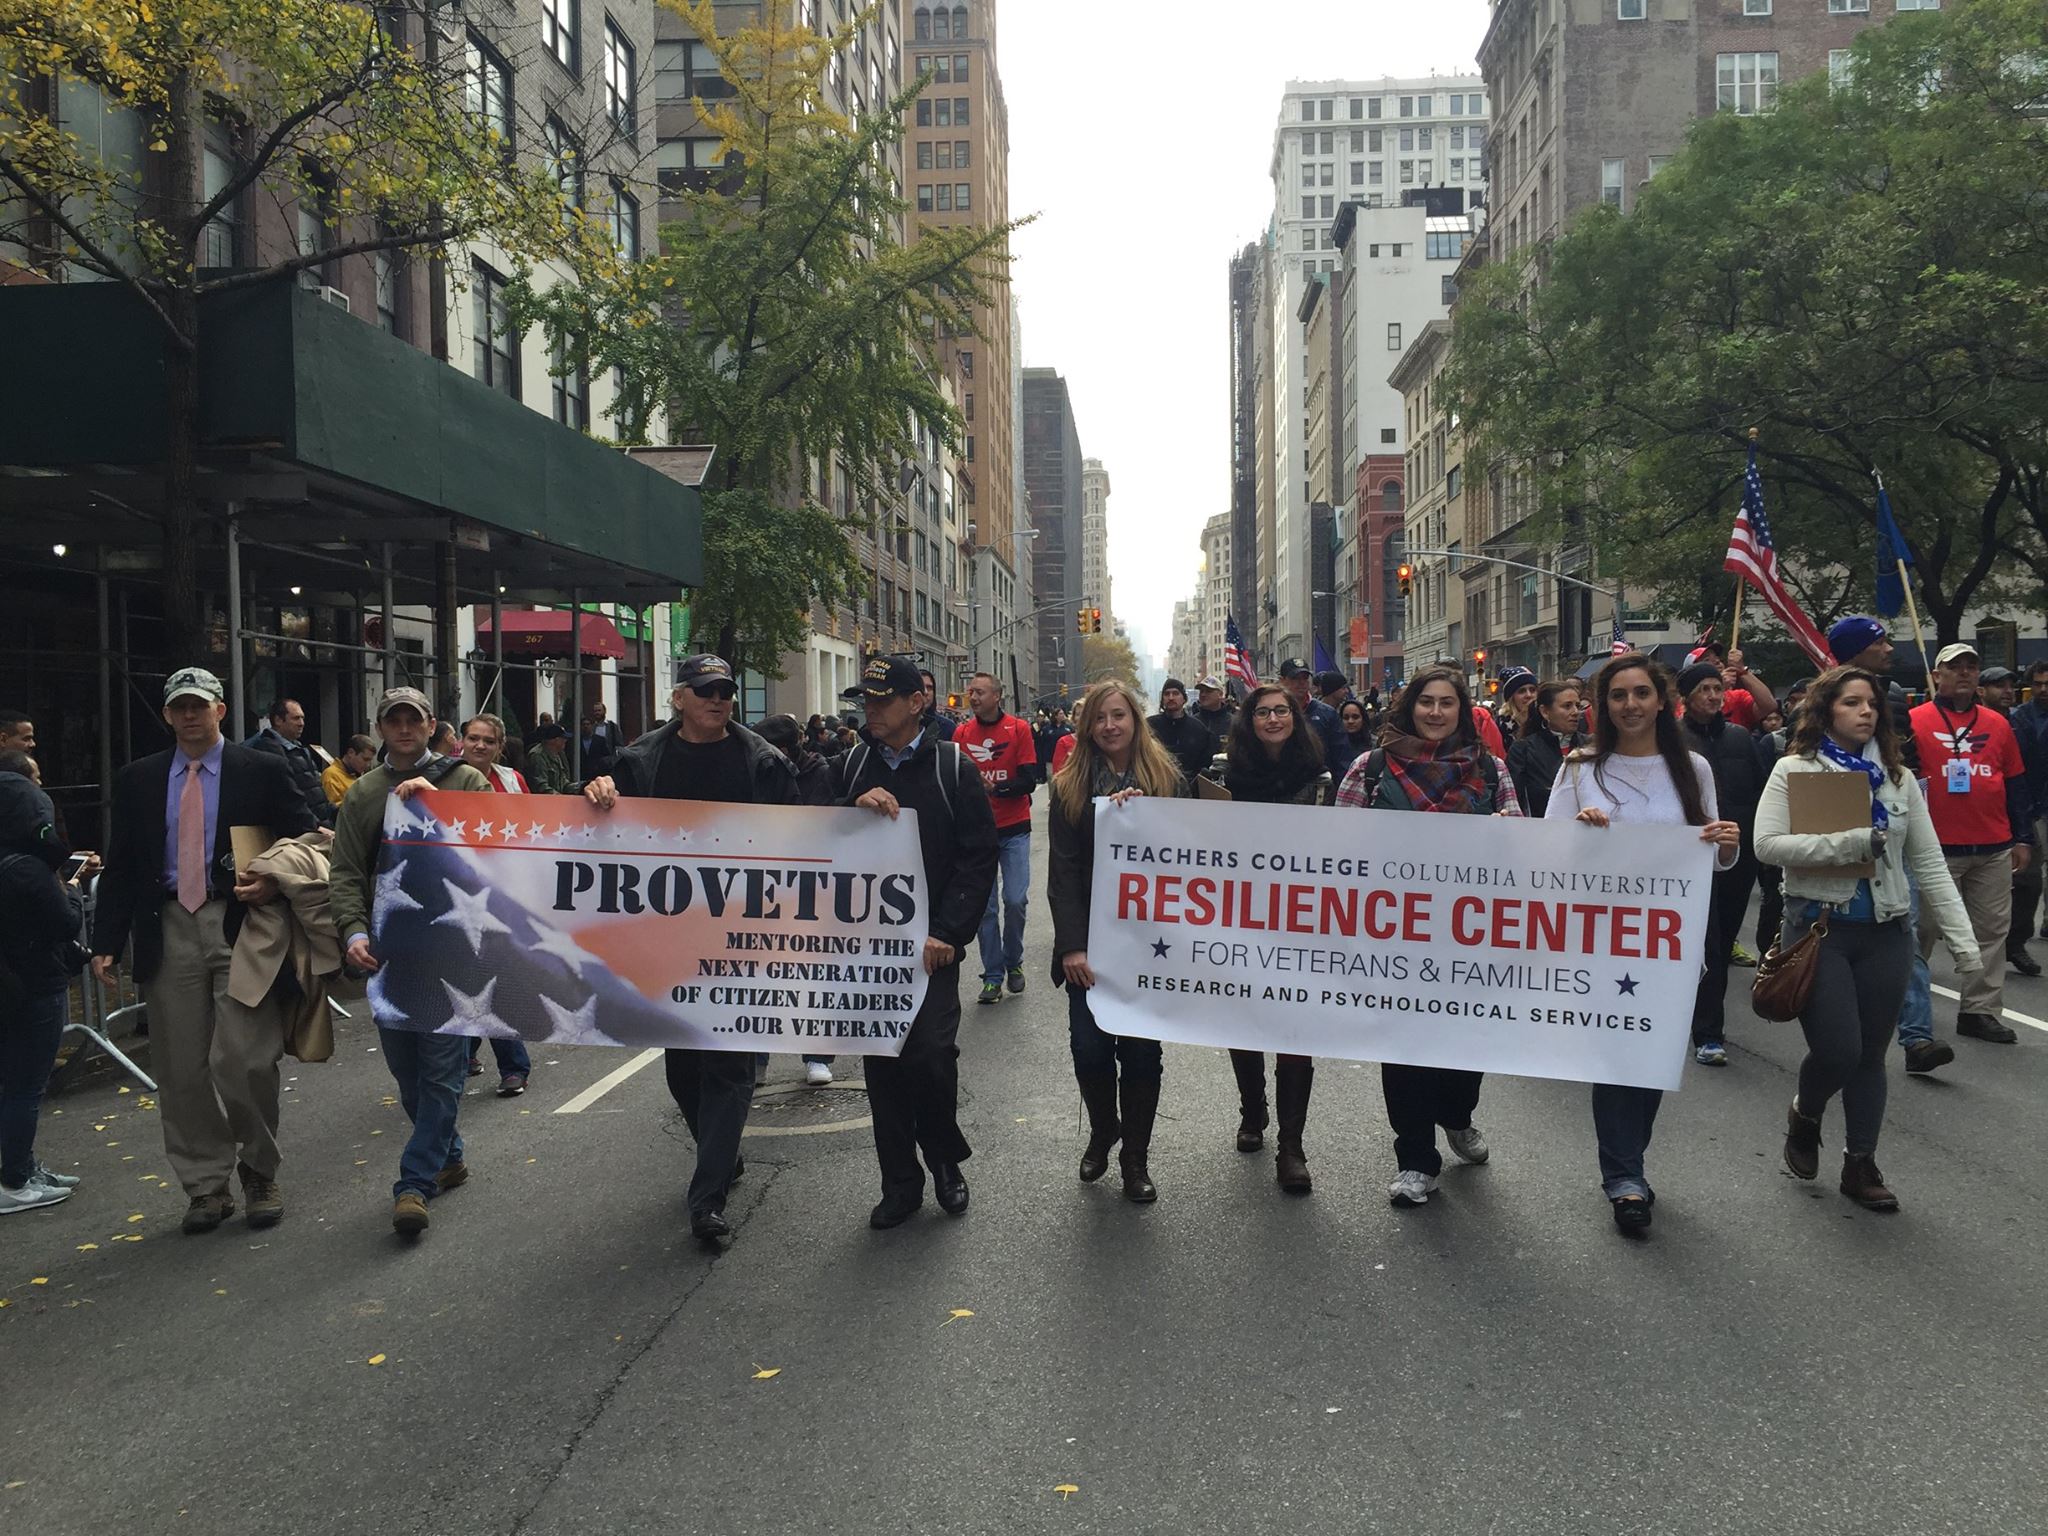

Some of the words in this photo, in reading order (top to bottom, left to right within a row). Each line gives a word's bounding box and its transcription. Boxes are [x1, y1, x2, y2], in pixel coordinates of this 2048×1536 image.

[525, 635, 543, 643] 267
[1110, 844, 1239, 868] TEACHERS
[1251, 853, 1369, 877] COLLEGE
[1382, 861, 1516, 887] COLUMBIA
[1530, 871, 1692, 898] UNIVERSITY
[552, 861, 915, 926] PROVETUS
[1117, 872, 1433, 942] RESILIENCE
[1451, 895, 1682, 961] CENTER
[726, 932, 861, 955] MENTORING
[869, 938, 914, 957] THE
[697, 958, 759, 978] NEXT
[766, 960, 914, 984] GENERATION
[1191, 940, 1248, 967] FOR
[1257, 945, 1409, 980] VETERANS
[1419, 957, 1441, 982] &
[1451, 960, 1591, 995] FAMILIES
[671, 985, 701, 1003] OF
[709, 986, 800, 1008] CITIZEN
[808, 991, 913, 1012] LEADERS
[1137, 975, 1252, 998] RESEARCH
[1262, 986, 1309, 1003] AND
[1321, 991, 1517, 1021] PSYCHOLOGICAL
[1530, 1008, 1652, 1032] SERVICES
[791, 1018, 910, 1038] VETERANS
